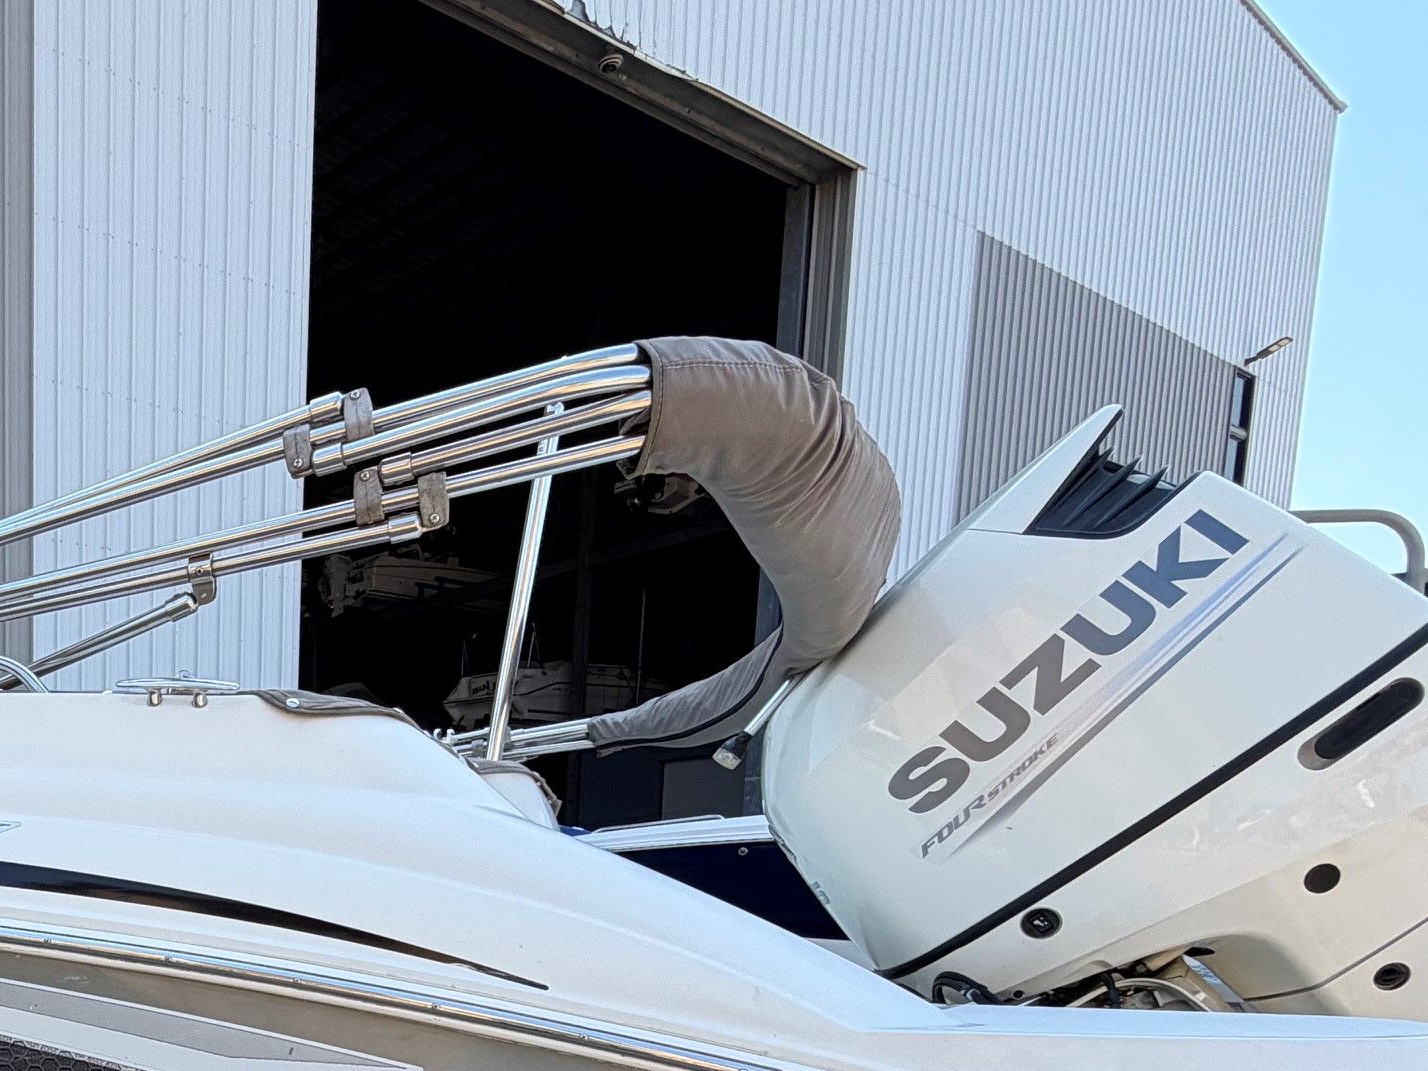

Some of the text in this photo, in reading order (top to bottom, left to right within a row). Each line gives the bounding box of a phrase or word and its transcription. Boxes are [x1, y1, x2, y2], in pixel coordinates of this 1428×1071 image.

[887, 508, 1251, 814] SUZUKI
[921, 733, 1059, 859] FOUR STROKE
